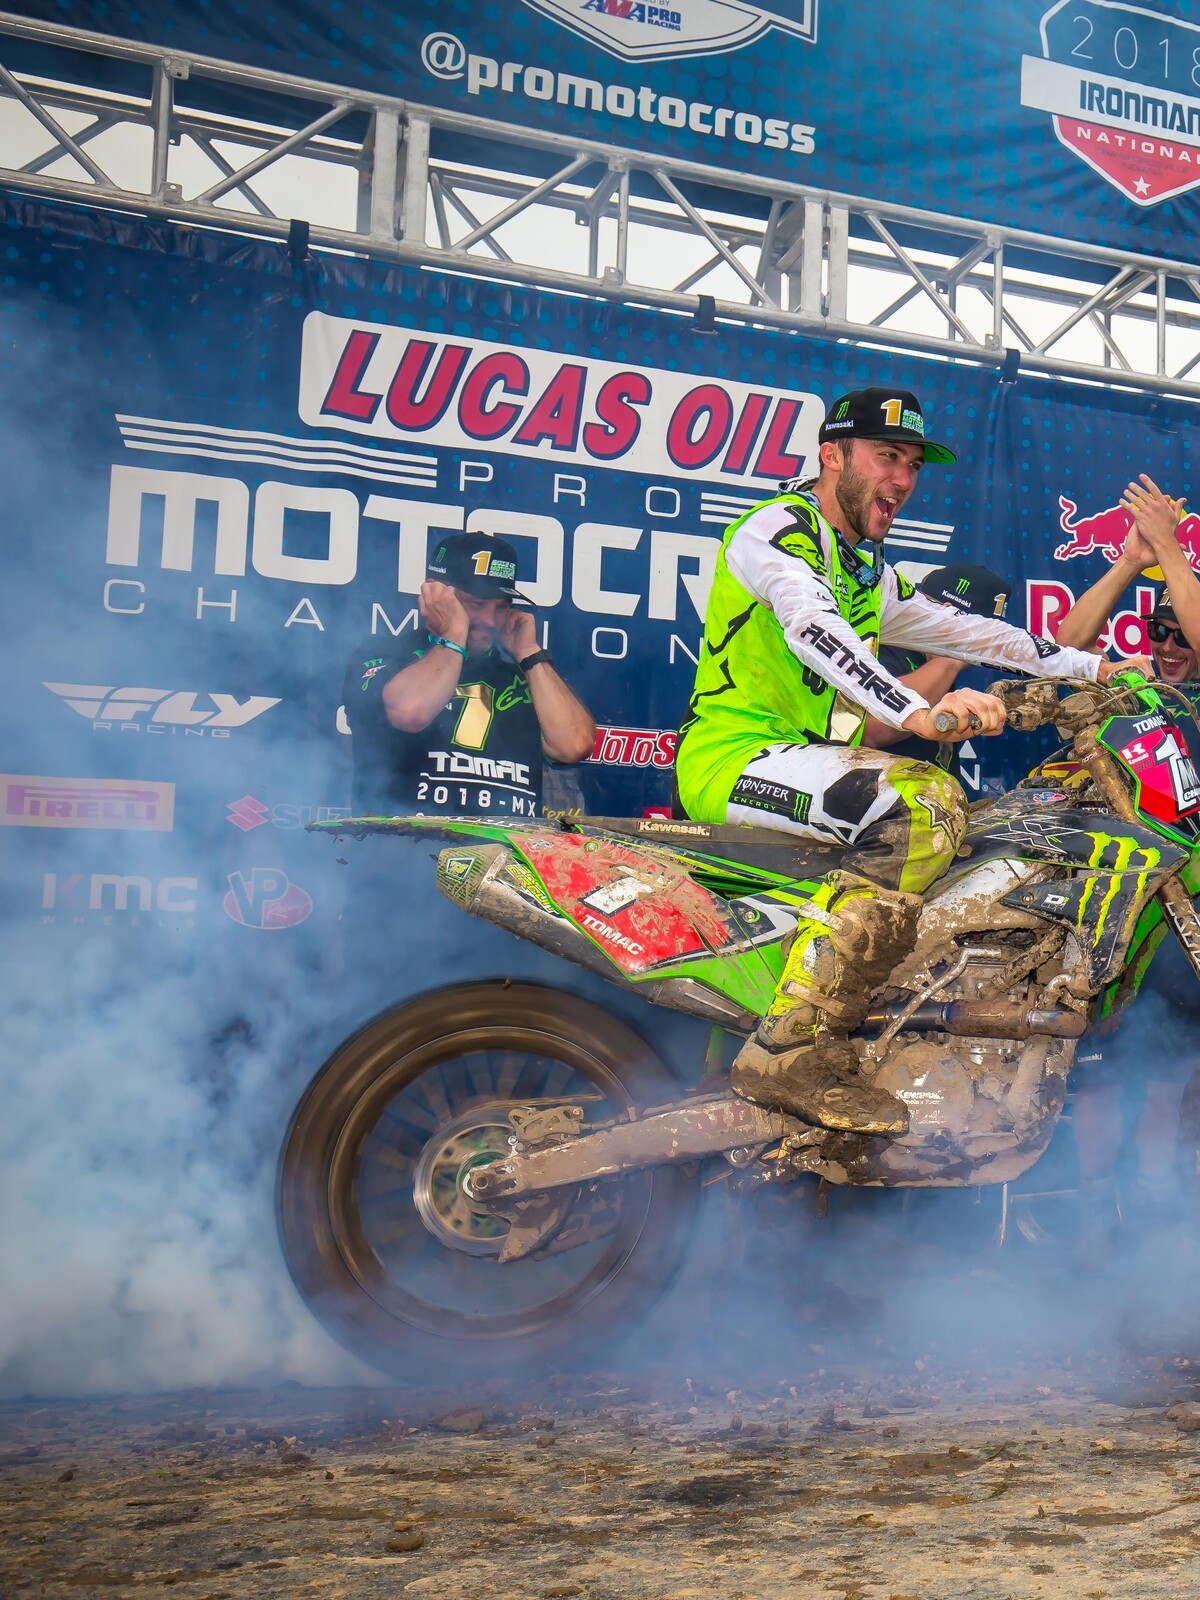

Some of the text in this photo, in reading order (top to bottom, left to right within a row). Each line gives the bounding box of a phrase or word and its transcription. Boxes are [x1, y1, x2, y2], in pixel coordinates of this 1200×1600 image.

[648, 5, 681, 24] PRO
[648, 18, 681, 31] RACING
[421, 31, 817, 155] @promotocross
[319, 329, 806, 480] LUCAS OIL
[879, 398, 903, 426] 1
[825, 419, 854, 431] Kawasaki
[459, 461, 681, 518] PRO
[472, 550, 492, 576] 1
[941, 589, 972, 609] Kawasaki
[103, 579, 704, 664] CHAMION
[799, 622, 912, 714] ASTARS
[97, 686, 283, 727] FLY
[92, 721, 231, 738] RACING
[1132, 715, 1168, 735] TOMAC
[428, 750, 530, 786] TOMAC
[1154, 731, 1198, 813] 1
[7, 784, 160, 822] PIRELLI
[270, 805, 354, 829] SUZ
[733, 796, 777, 812] ENERGY
[226, 867, 290, 928] VP
[42, 915, 195, 928] WHEELS
[581, 913, 645, 957] TOMAC
